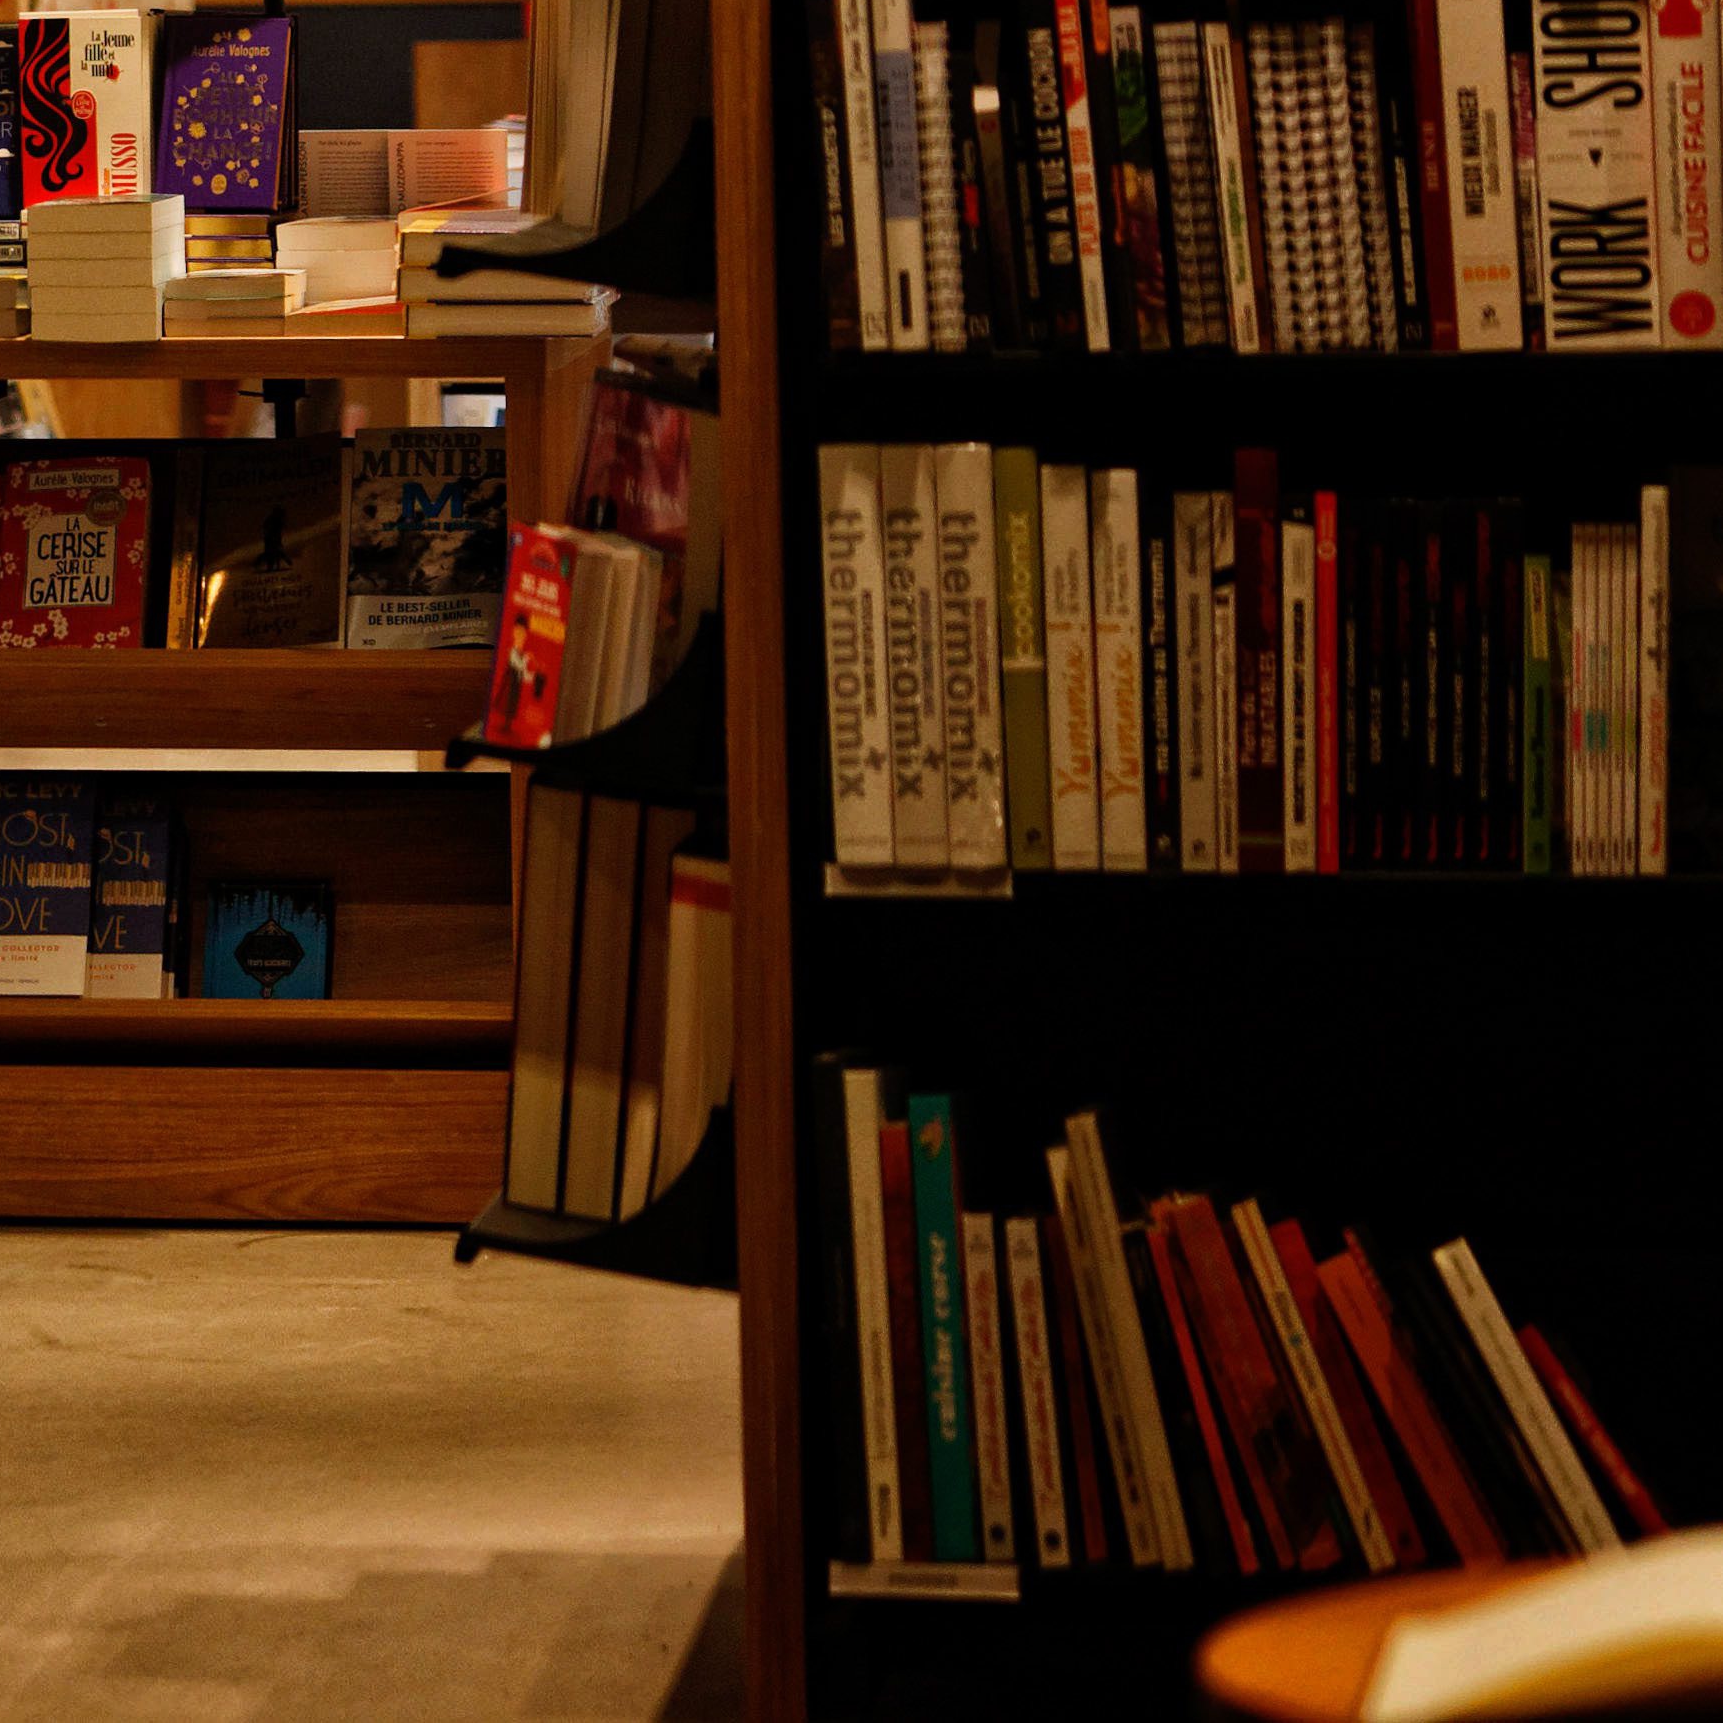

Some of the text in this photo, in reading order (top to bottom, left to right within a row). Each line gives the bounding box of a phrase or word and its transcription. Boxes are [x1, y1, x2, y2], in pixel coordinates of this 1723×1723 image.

[100, 29, 135, 49] Jeune
[84, 42, 110, 62] fille
[191, 43, 271, 59] Aurélie Valognes
[91, 62, 115, 78] nuit
[1027, 27, 1061, 120] COCHON
[1456, 85, 1481, 159] MANGER
[111, 133, 138, 196] MUSSO
[1679, 62, 1711, 265] CUISINE FACILE
[1547, 196, 1654, 339] WORK
[389, 431, 482, 450] BERNARD
[33, 472, 115, 488] Aurélie Valognes
[402, 481, 466, 519] M
[65, 515, 81, 532] LA
[36, 530, 109, 562] CERISE
[56, 558, 95, 576] SUR LE
[29, 572, 110, 606] GÂTEAU
[379, 598, 471, 614] LE BEST-SELLER
[367, 608, 482, 627] DE BERNARD MINIER
[827, 508, 867, 800] thermomix
[885, 506, 925, 800] thermomix
[940, 508, 980, 801] thermomix
[24, 781, 83, 800] LEVY
[1, 943, 61, 953] COLLECTOR
